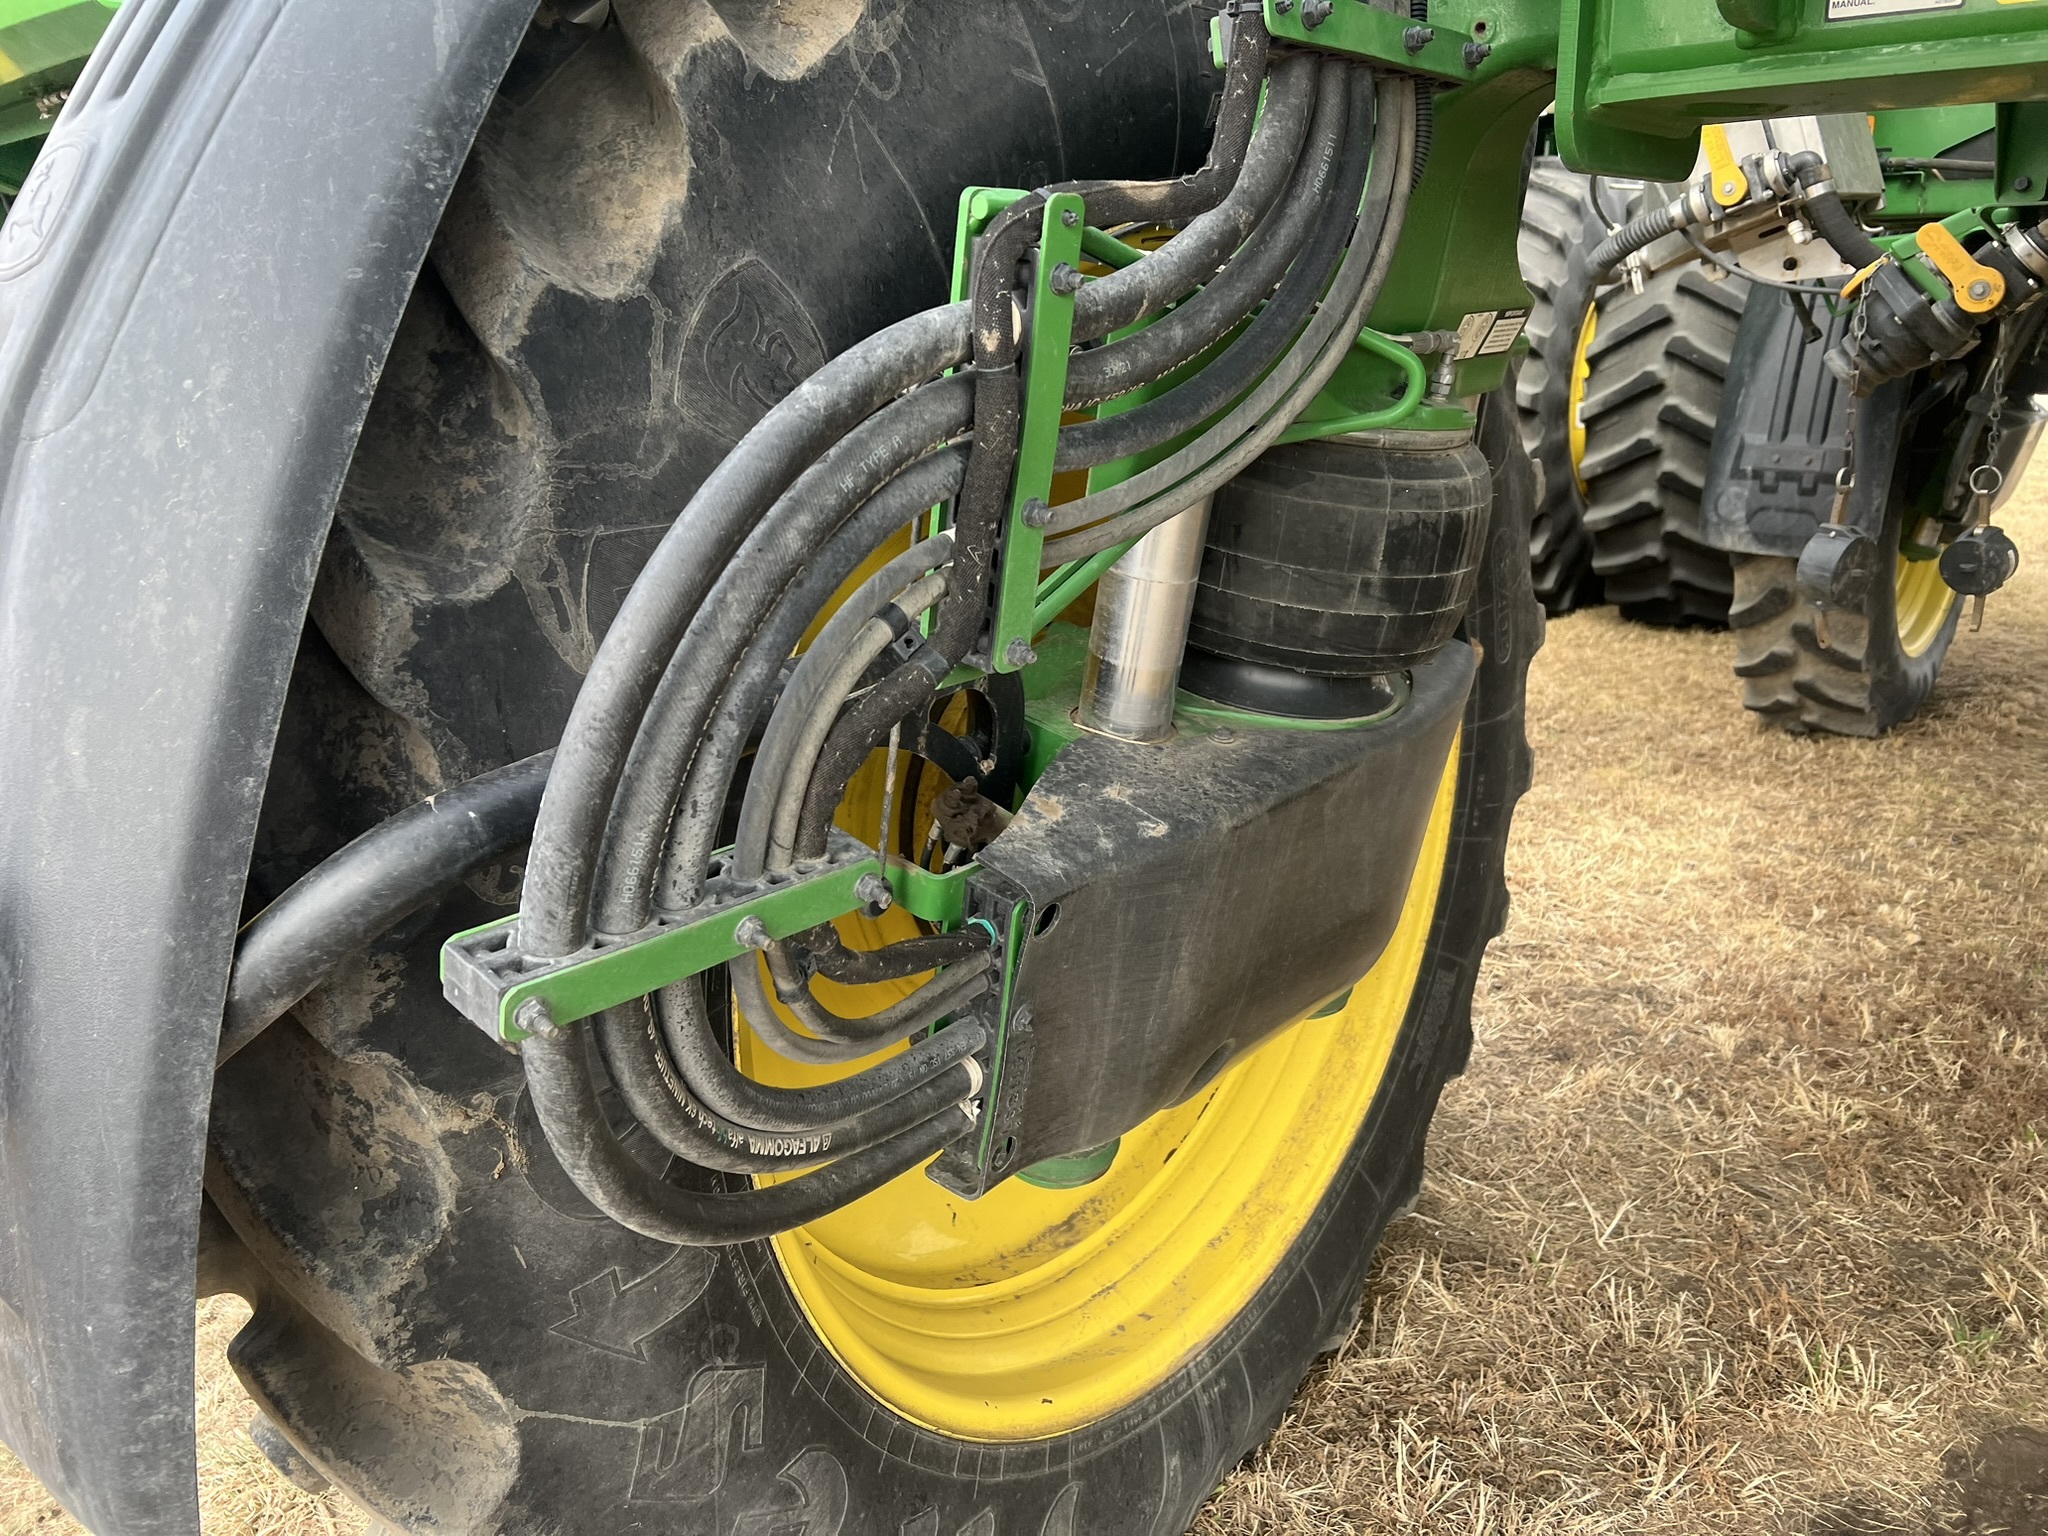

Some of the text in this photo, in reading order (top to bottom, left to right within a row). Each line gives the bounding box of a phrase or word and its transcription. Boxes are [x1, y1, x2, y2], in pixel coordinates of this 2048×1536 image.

[1312, 133, 1338, 194] H0661511
[840, 472, 855, 493] HF
[859, 444, 890, 473] TYPE
[749, 1135, 822, 1157] ALFAGOMMA
